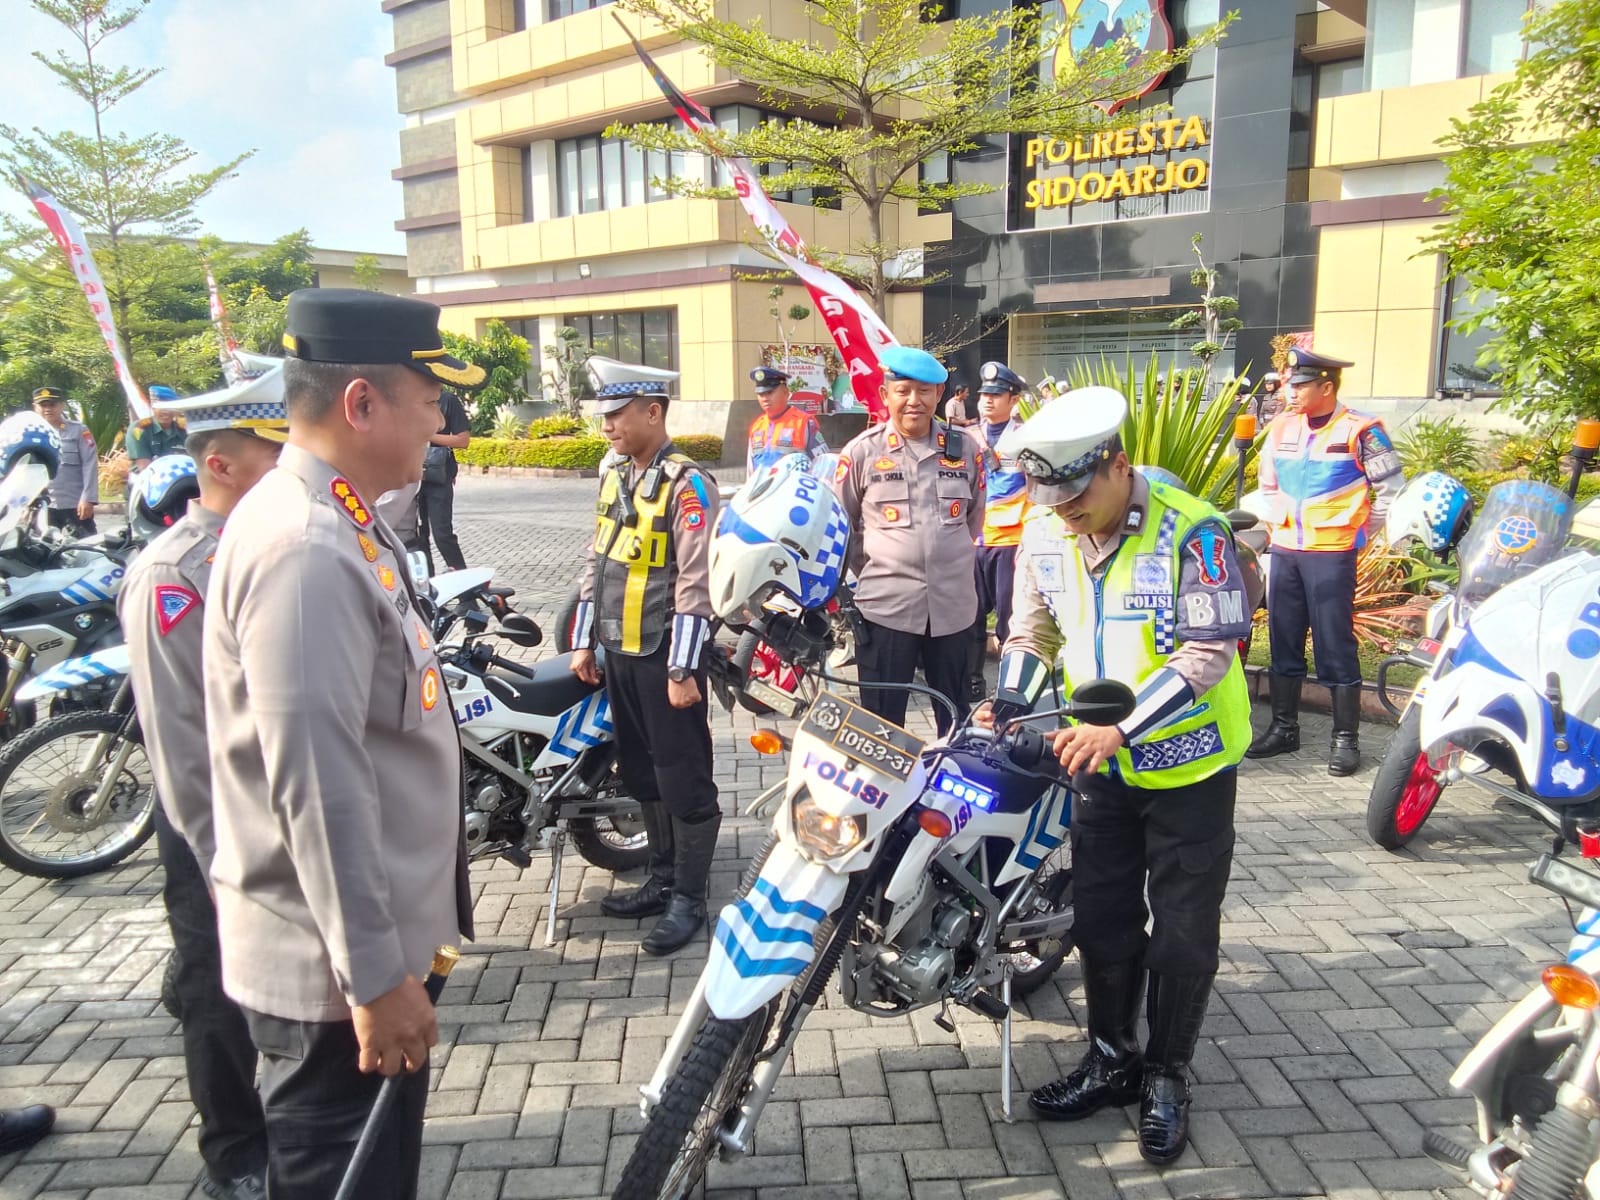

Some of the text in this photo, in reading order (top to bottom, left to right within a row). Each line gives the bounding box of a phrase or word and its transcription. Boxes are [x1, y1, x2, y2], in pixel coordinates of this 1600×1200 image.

[1025, 114, 1206, 168] POLRESTA
[1025, 157, 1206, 209] SIDOARJO
[1124, 594, 1173, 609] POLISI
[36, 638, 64, 652] GS
[455, 695, 493, 725] LISI
[838, 728, 913, 775] 10153-31
[803, 752, 889, 810] POLISI
[953, 800, 972, 834] ISI
